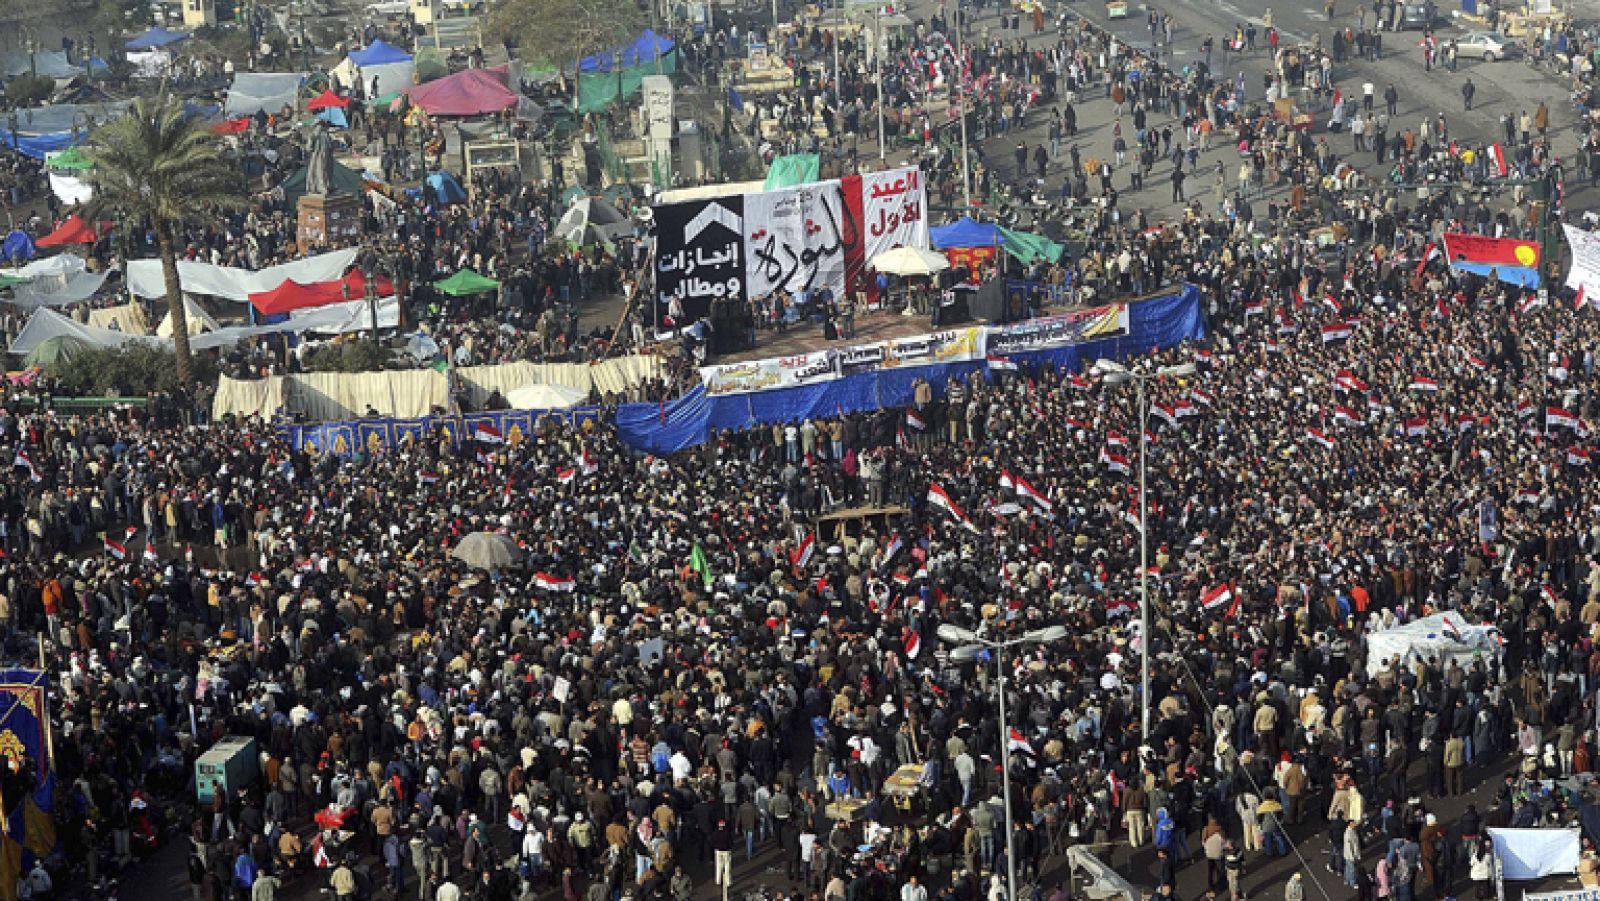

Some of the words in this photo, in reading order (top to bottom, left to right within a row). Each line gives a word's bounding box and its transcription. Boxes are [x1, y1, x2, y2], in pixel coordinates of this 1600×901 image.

[871, 170, 918, 203] العيد
[871, 195, 921, 237] الأول
[658, 241, 738, 275] إنجازات
[660, 277, 740, 304] ومطالب
